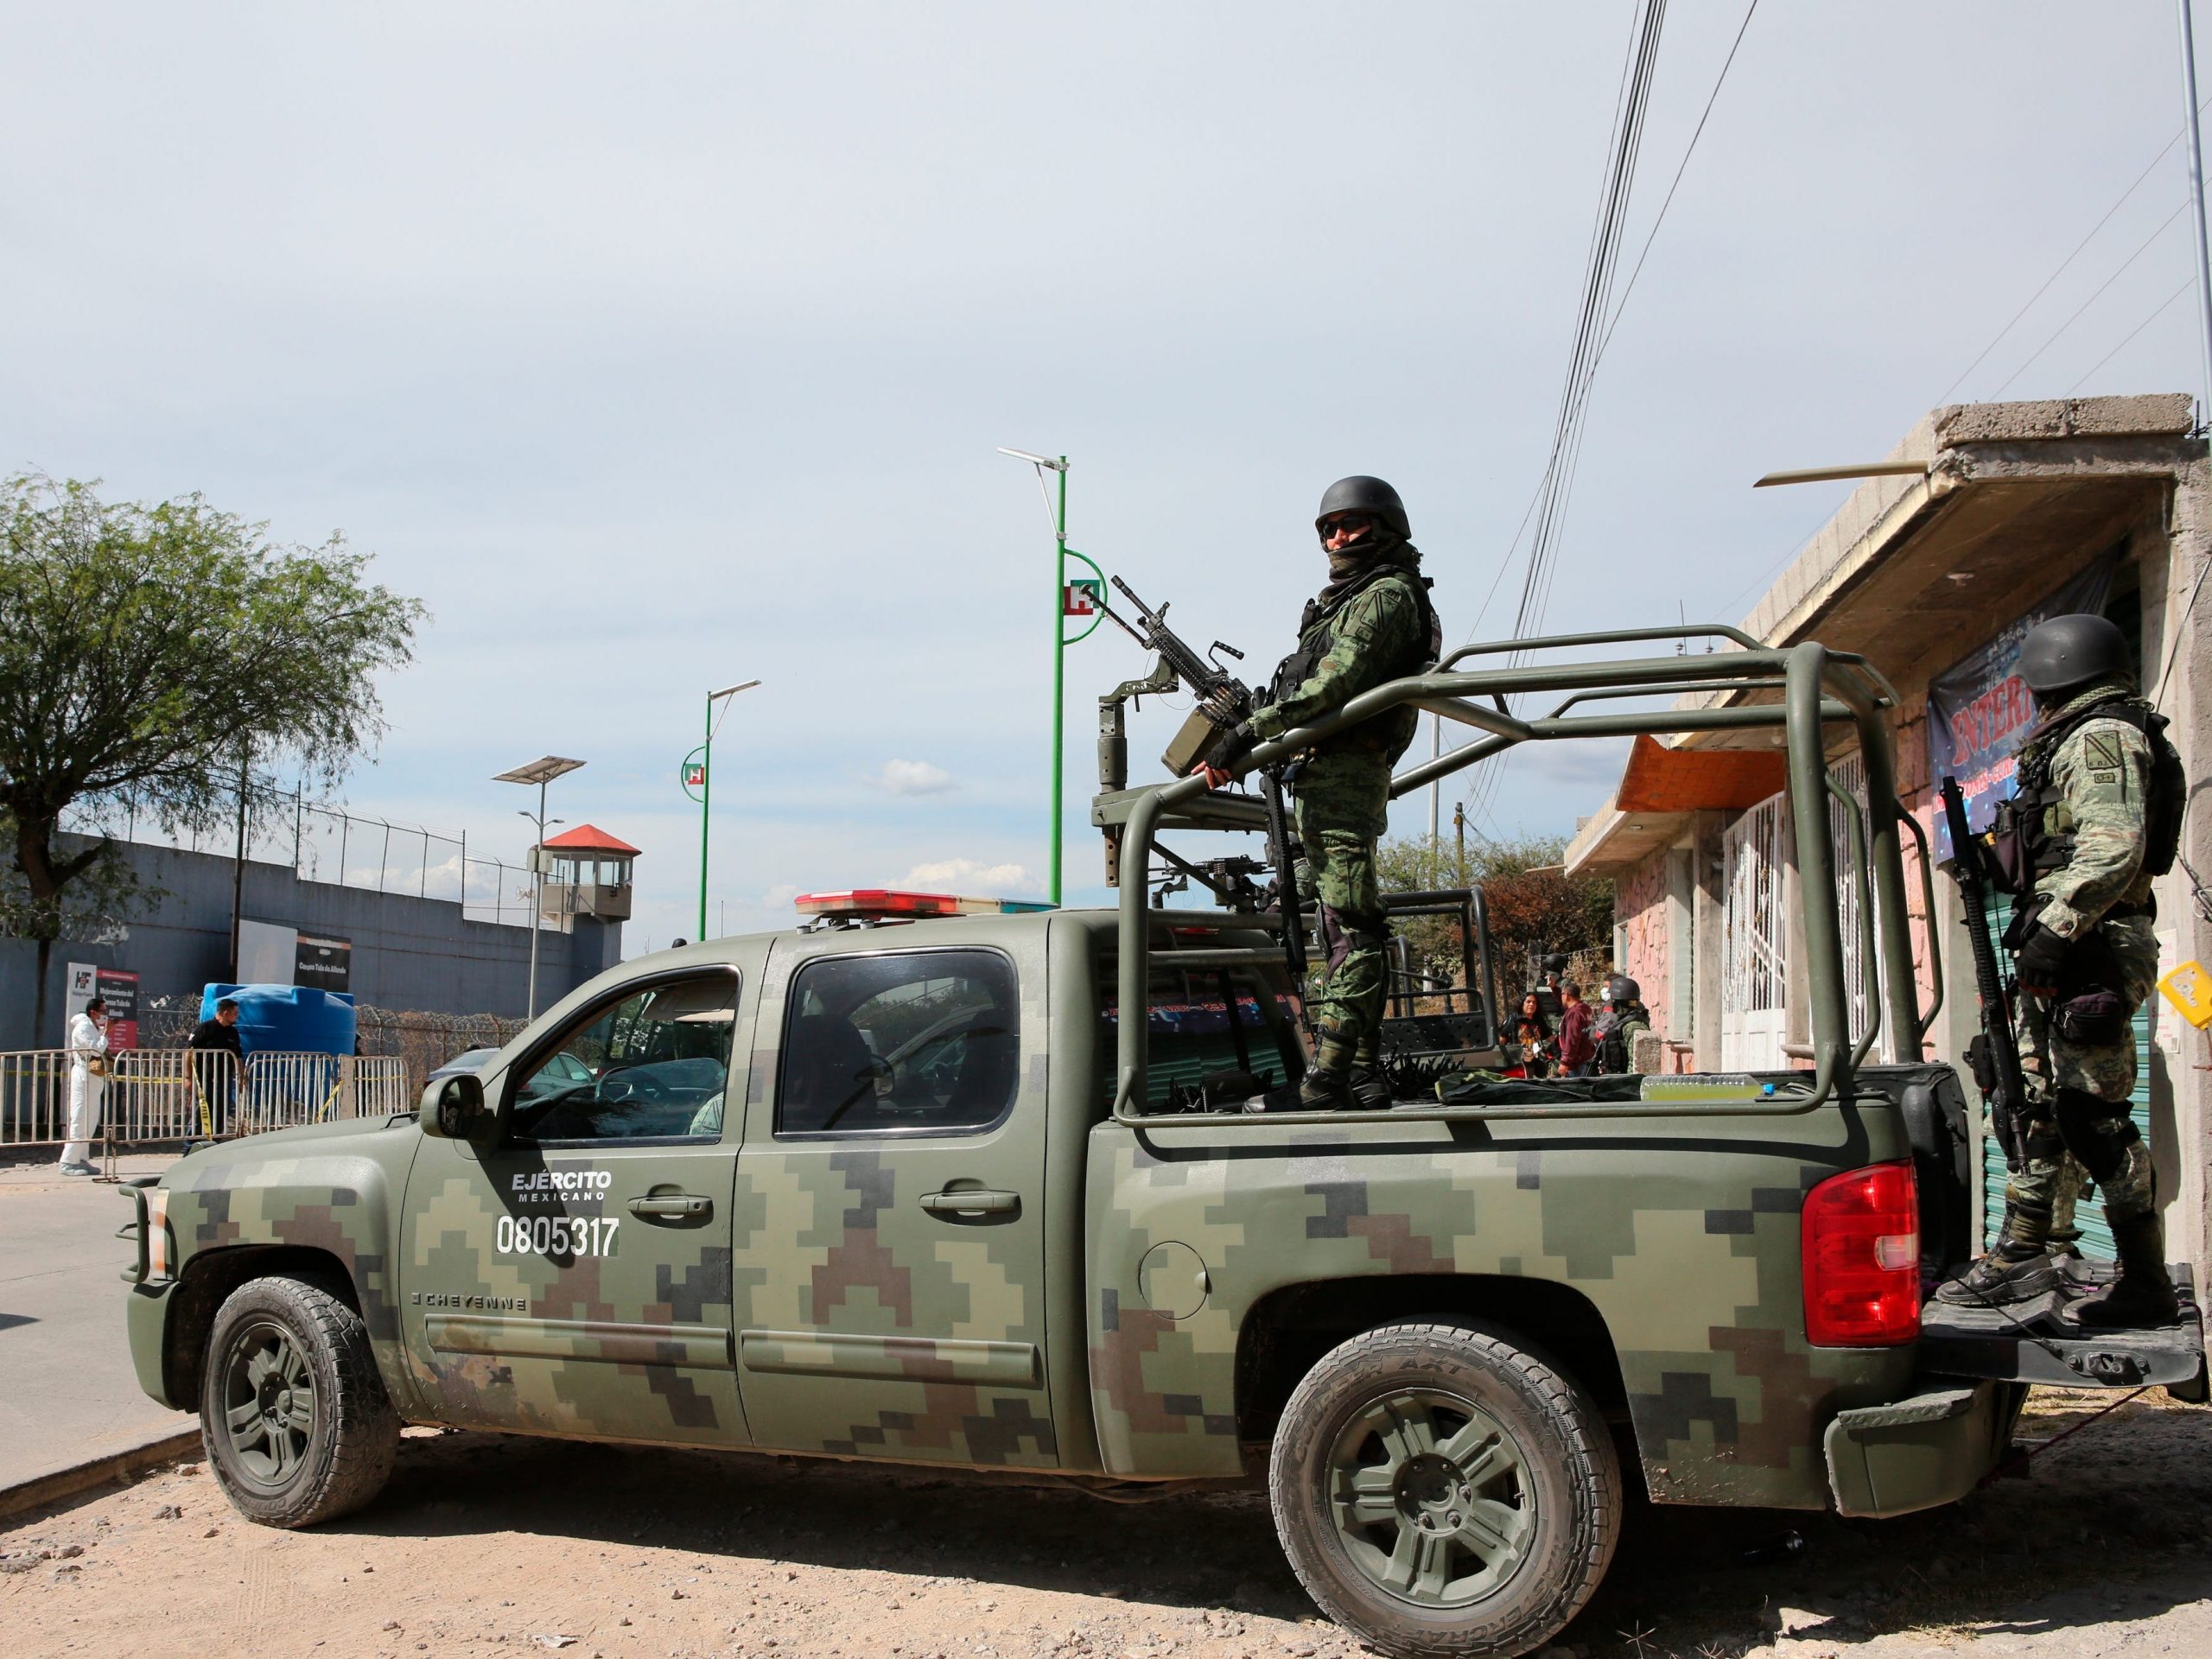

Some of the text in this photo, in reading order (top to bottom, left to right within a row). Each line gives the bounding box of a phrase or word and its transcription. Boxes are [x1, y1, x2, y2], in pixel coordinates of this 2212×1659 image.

[512, 1168, 612, 1190] EJÉRCITO
[518, 1192, 604, 1202] MEXICANO
[496, 1215, 620, 1256] 0805317
[426, 1293, 526, 1311] CHEYENNE
